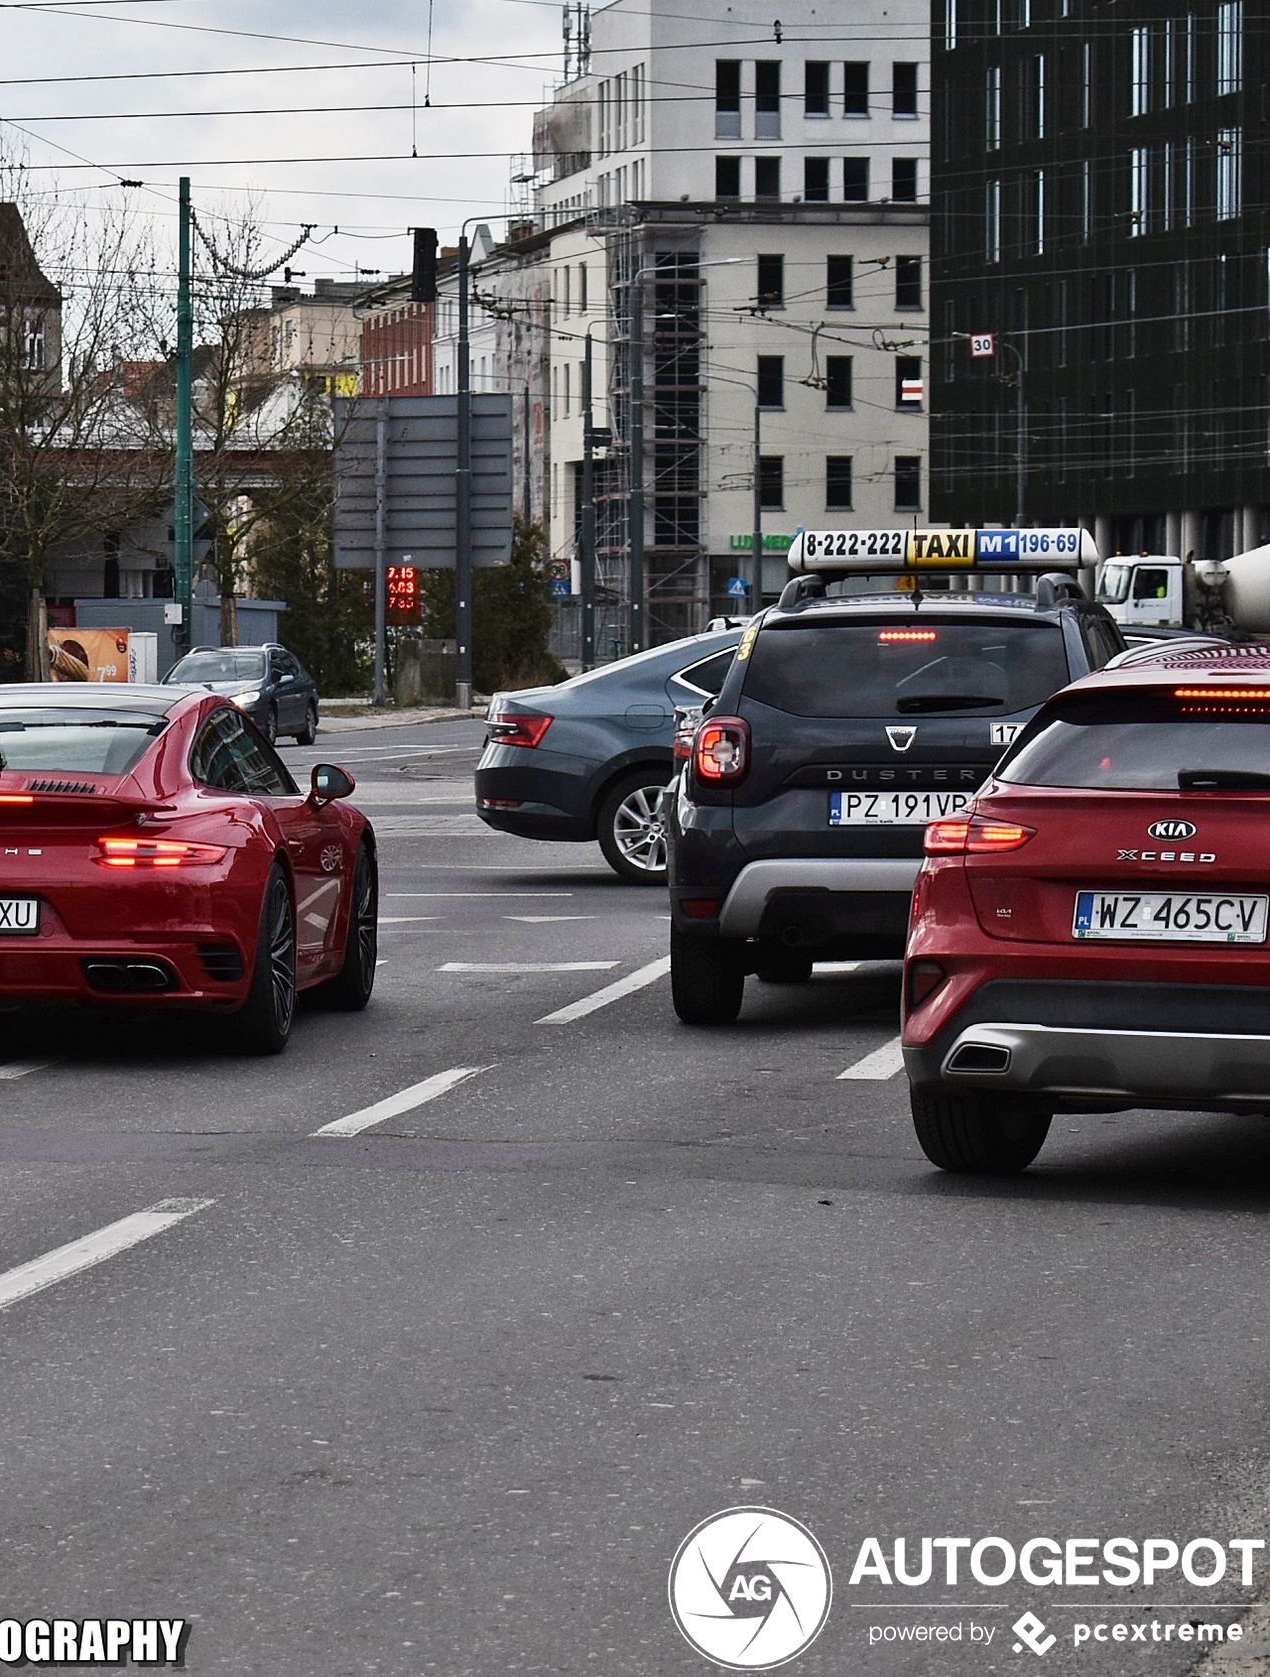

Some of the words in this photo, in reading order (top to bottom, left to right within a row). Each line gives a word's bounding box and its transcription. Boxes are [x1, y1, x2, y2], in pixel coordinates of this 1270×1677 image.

[974, 339, 990, 351] 30
[807, 533, 901, 556] 8-222-222
[913, 534, 970, 558] TAXI
[1020, 534, 1077, 553] 196-69
[388, 567, 414, 578] 7.15
[826, 770, 976, 780] DUSTER
[847, 795, 879, 818] PZ
[1154, 824, 1187, 837] KIA
[1116, 849, 1217, 863] XCEED
[1078, 916, 1089, 925] PL
[1099, 896, 1141, 928] WZ
[1153, 898, 1258, 931] 465CV
